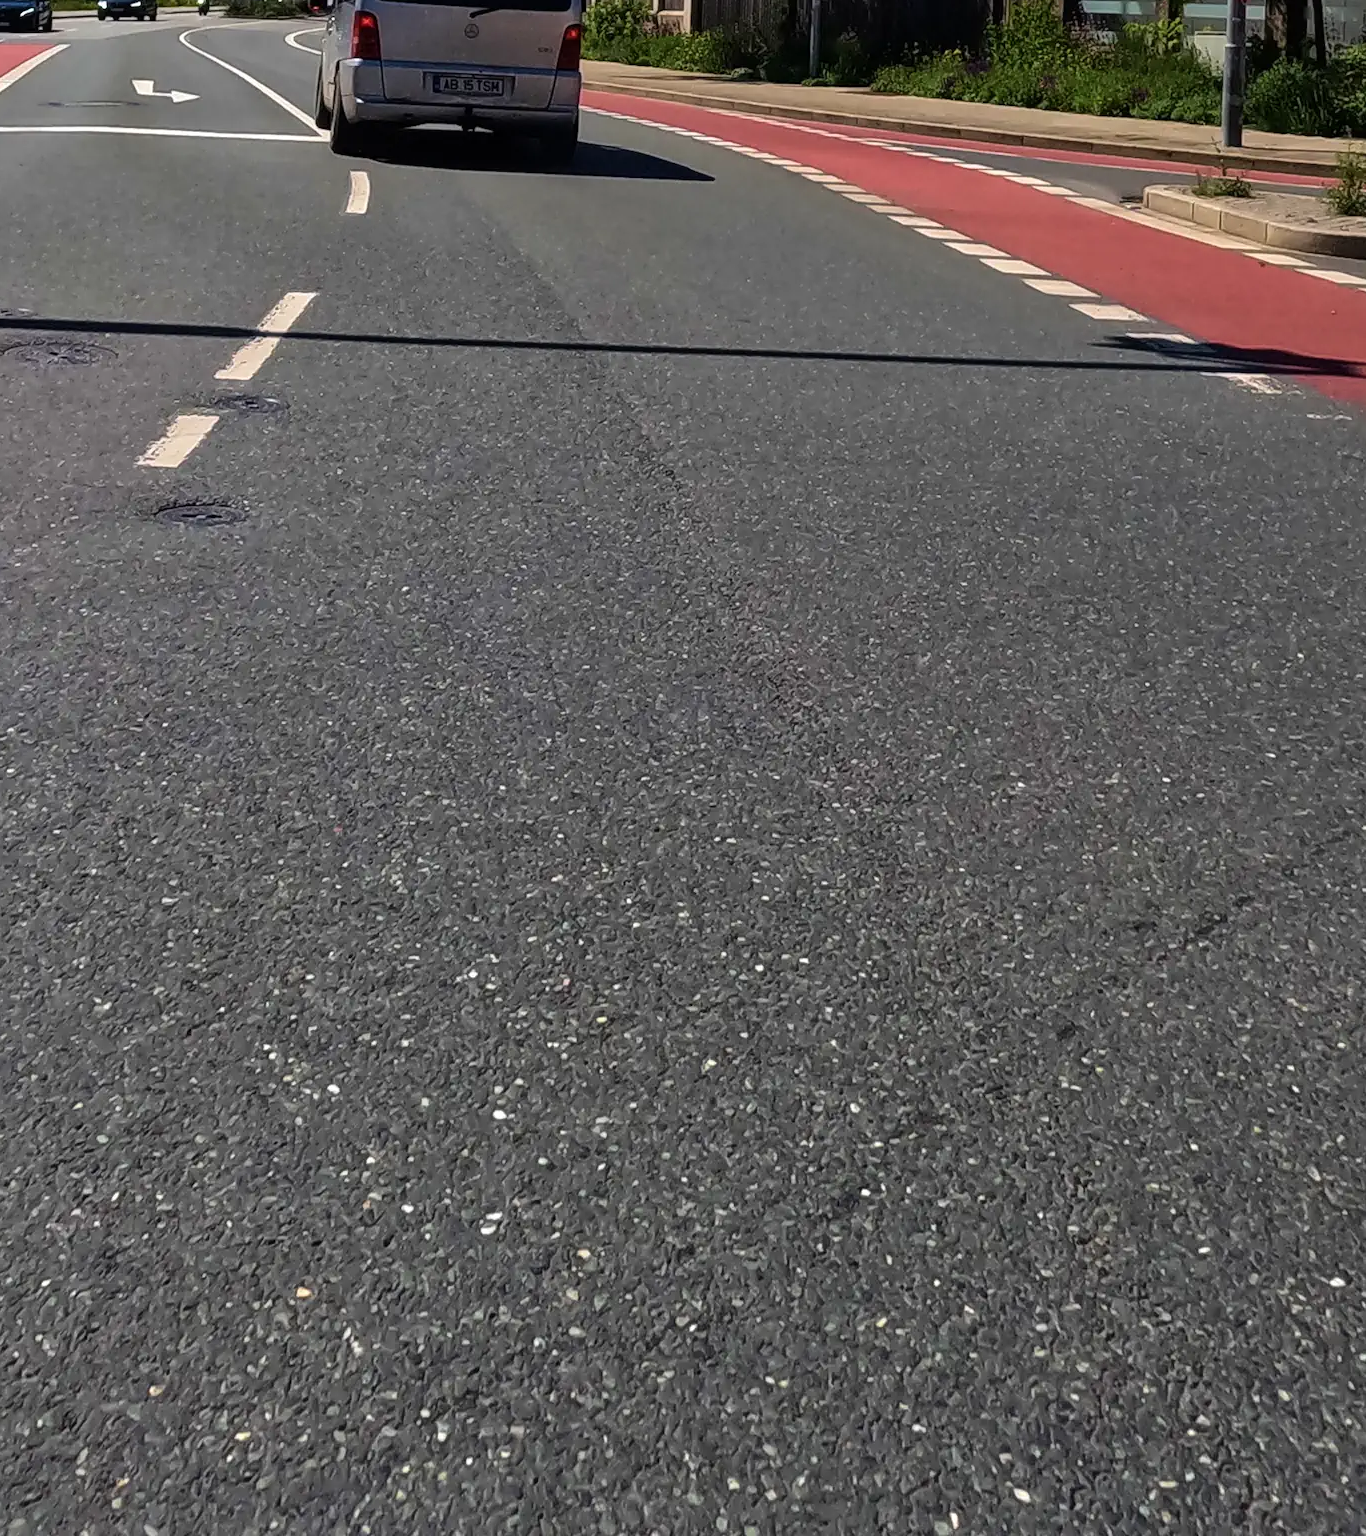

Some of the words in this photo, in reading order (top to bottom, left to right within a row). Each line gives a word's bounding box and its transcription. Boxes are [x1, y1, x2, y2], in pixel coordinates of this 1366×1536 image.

[444, 78, 459, 90] AB
[463, 79, 474, 91] 15
[476, 80, 500, 92] TSM
